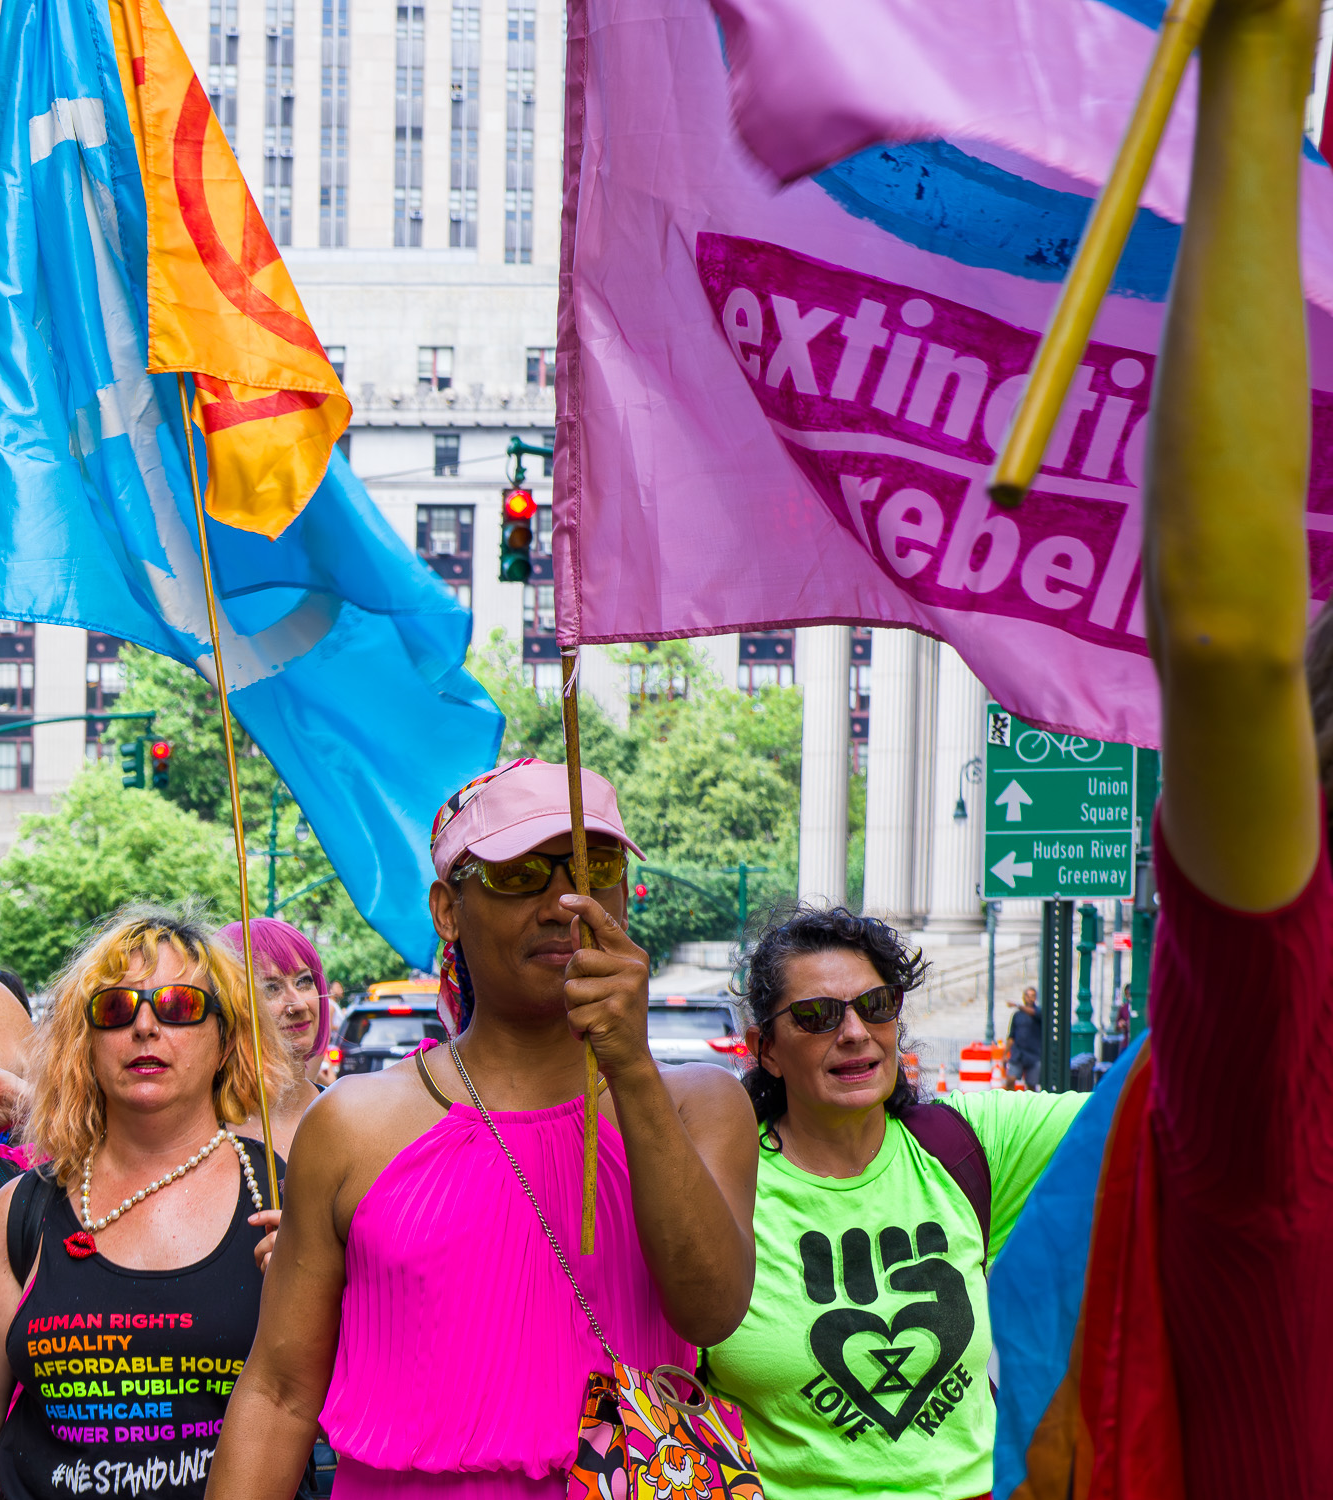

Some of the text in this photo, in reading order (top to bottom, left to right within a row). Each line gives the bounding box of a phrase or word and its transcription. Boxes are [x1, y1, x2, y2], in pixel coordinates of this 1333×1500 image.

[1088, 777, 1129, 795] Union
[1080, 803, 1129, 825] Square
[1033, 840, 1127, 859] Hudson River
[1058, 866, 1127, 887] Greenway
[28, 1313, 193, 1335] HUMAN RIGHTS
[28, 1335, 133, 1357] EQUALITY
[34, 1356, 245, 1378] AFFORDABLE HOUS
[40, 1380, 115, 1398] GLOBAL
[121, 1378, 200, 1397] PUBLIC
[800, 1373, 875, 1443] LOVE
[915, 1362, 974, 1437] RAGE
[45, 1402, 173, 1420] HEALTHCARE
[50, 1424, 109, 1443] LOWER
[114, 1424, 175, 1443] DRUG
